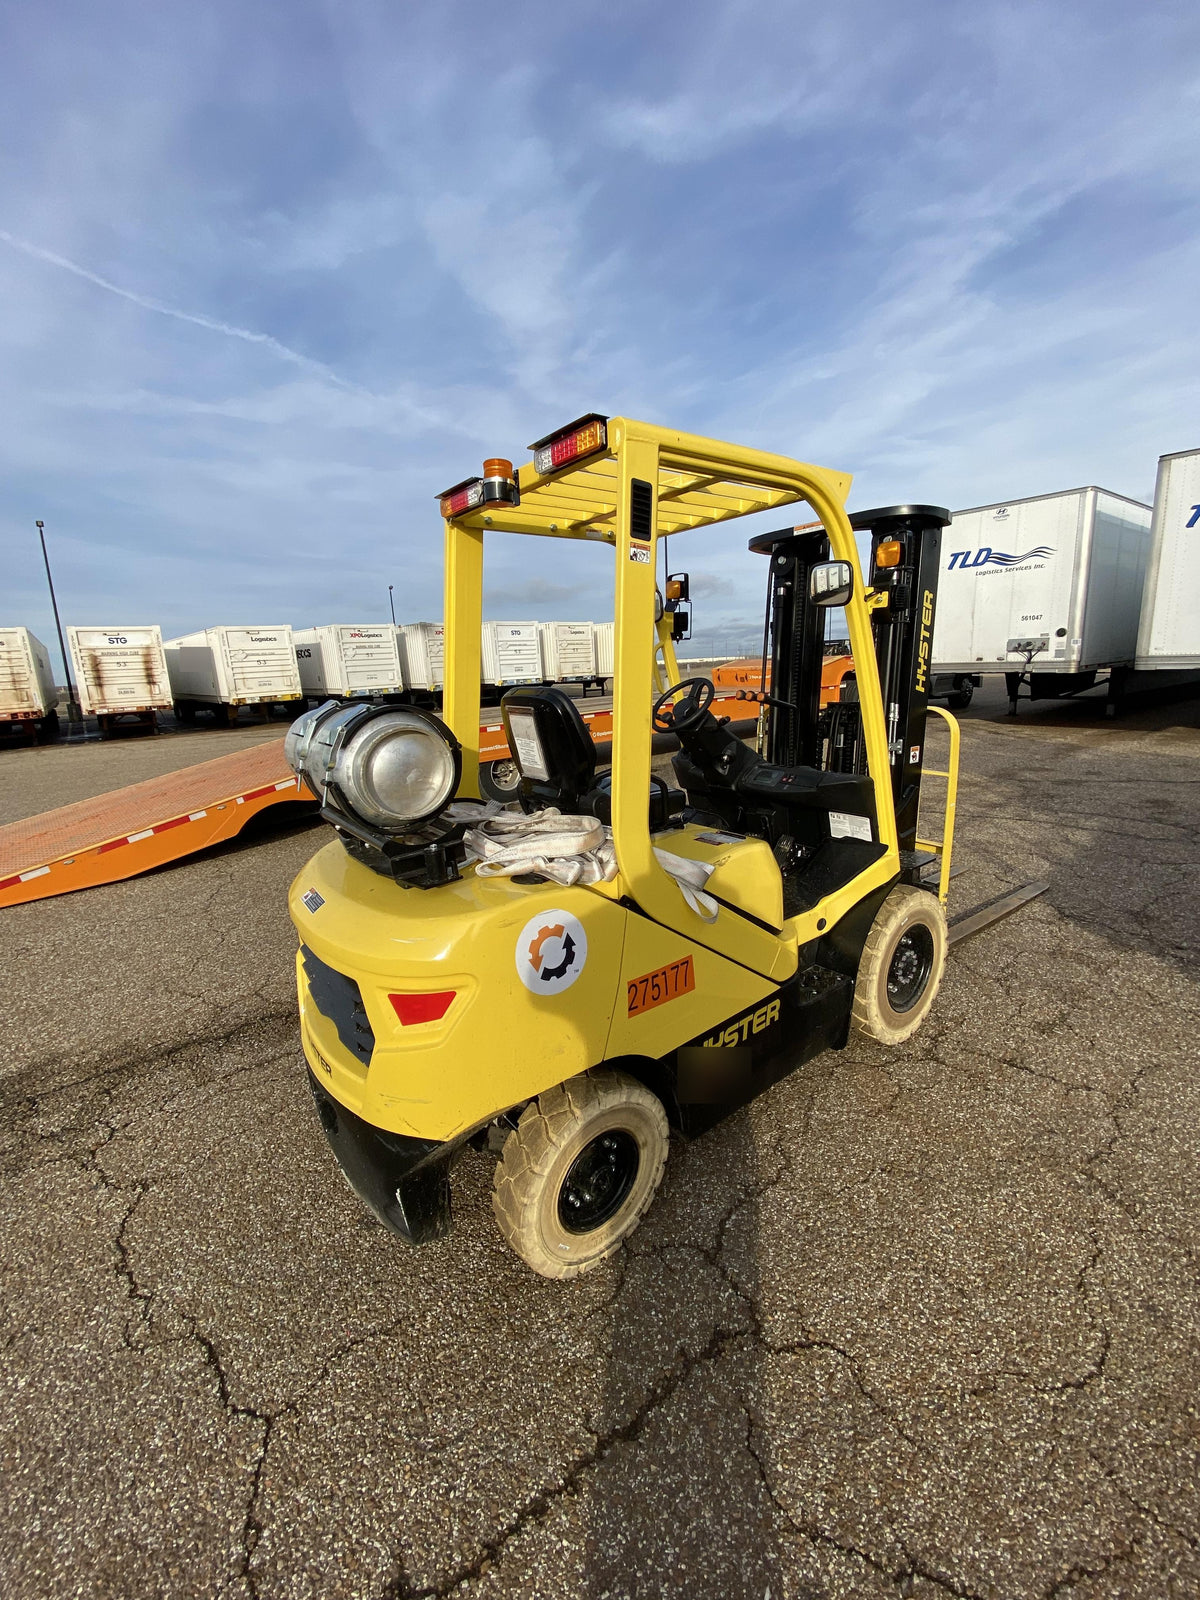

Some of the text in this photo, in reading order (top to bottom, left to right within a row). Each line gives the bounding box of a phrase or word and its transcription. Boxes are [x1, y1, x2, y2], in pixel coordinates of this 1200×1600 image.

[947, 547, 992, 570] TLD
[975, 567, 1003, 576] Logistics
[1004, 565, 1032, 573] Services
[108, 637, 128, 645] STG
[915, 589, 934, 693] HYSTER
[627, 959, 689, 1012] 275177
